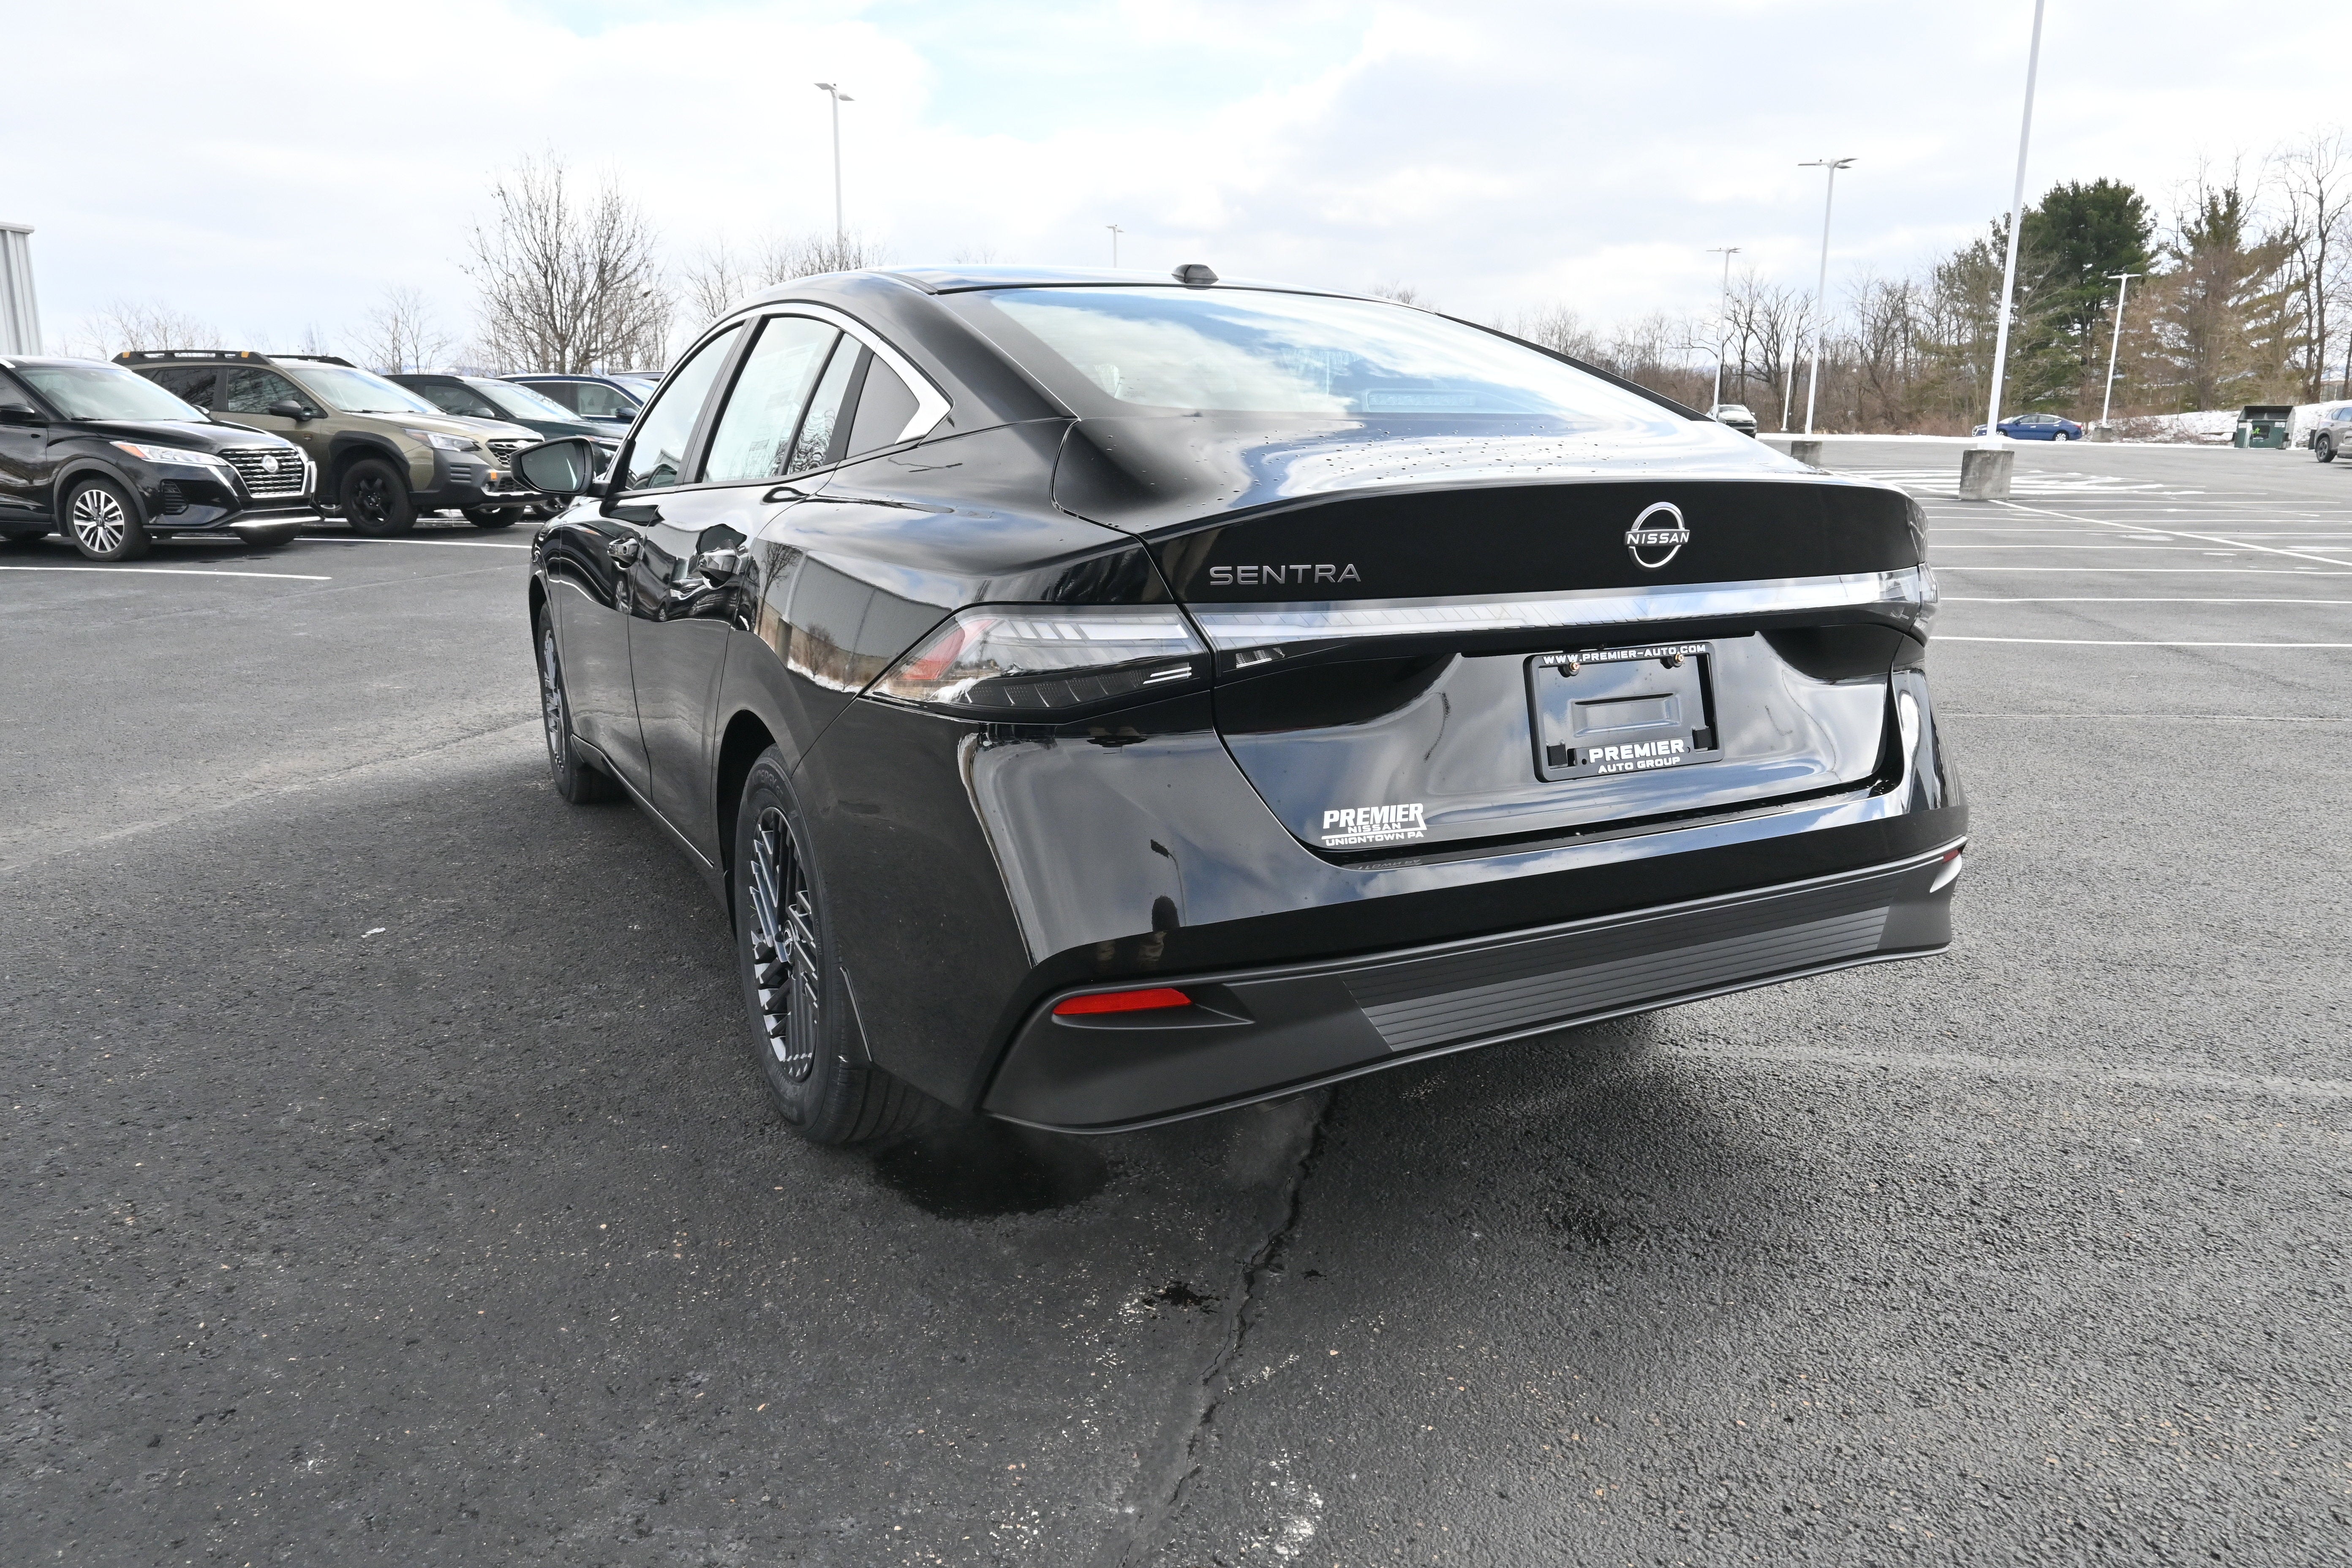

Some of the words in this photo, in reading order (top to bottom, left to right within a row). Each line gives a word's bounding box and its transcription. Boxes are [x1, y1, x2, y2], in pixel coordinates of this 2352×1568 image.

[1627, 532, 1689, 544] NISSAN
[1209, 564, 1361, 585] SENTRA
[1543, 645, 1706, 664] WWW.PREMIER-AUTO.COM
[1589, 739, 1685, 763] PREMIER
[1598, 762, 1633, 774] AUTO
[1637, 757, 1680, 769] GROUP
[1323, 803, 1426, 830] PREMIER
[1348, 822, 1401, 833] NISSAN
[1326, 832, 1405, 846] UNIONTOWN
[1407, 830, 1424, 838] PA
